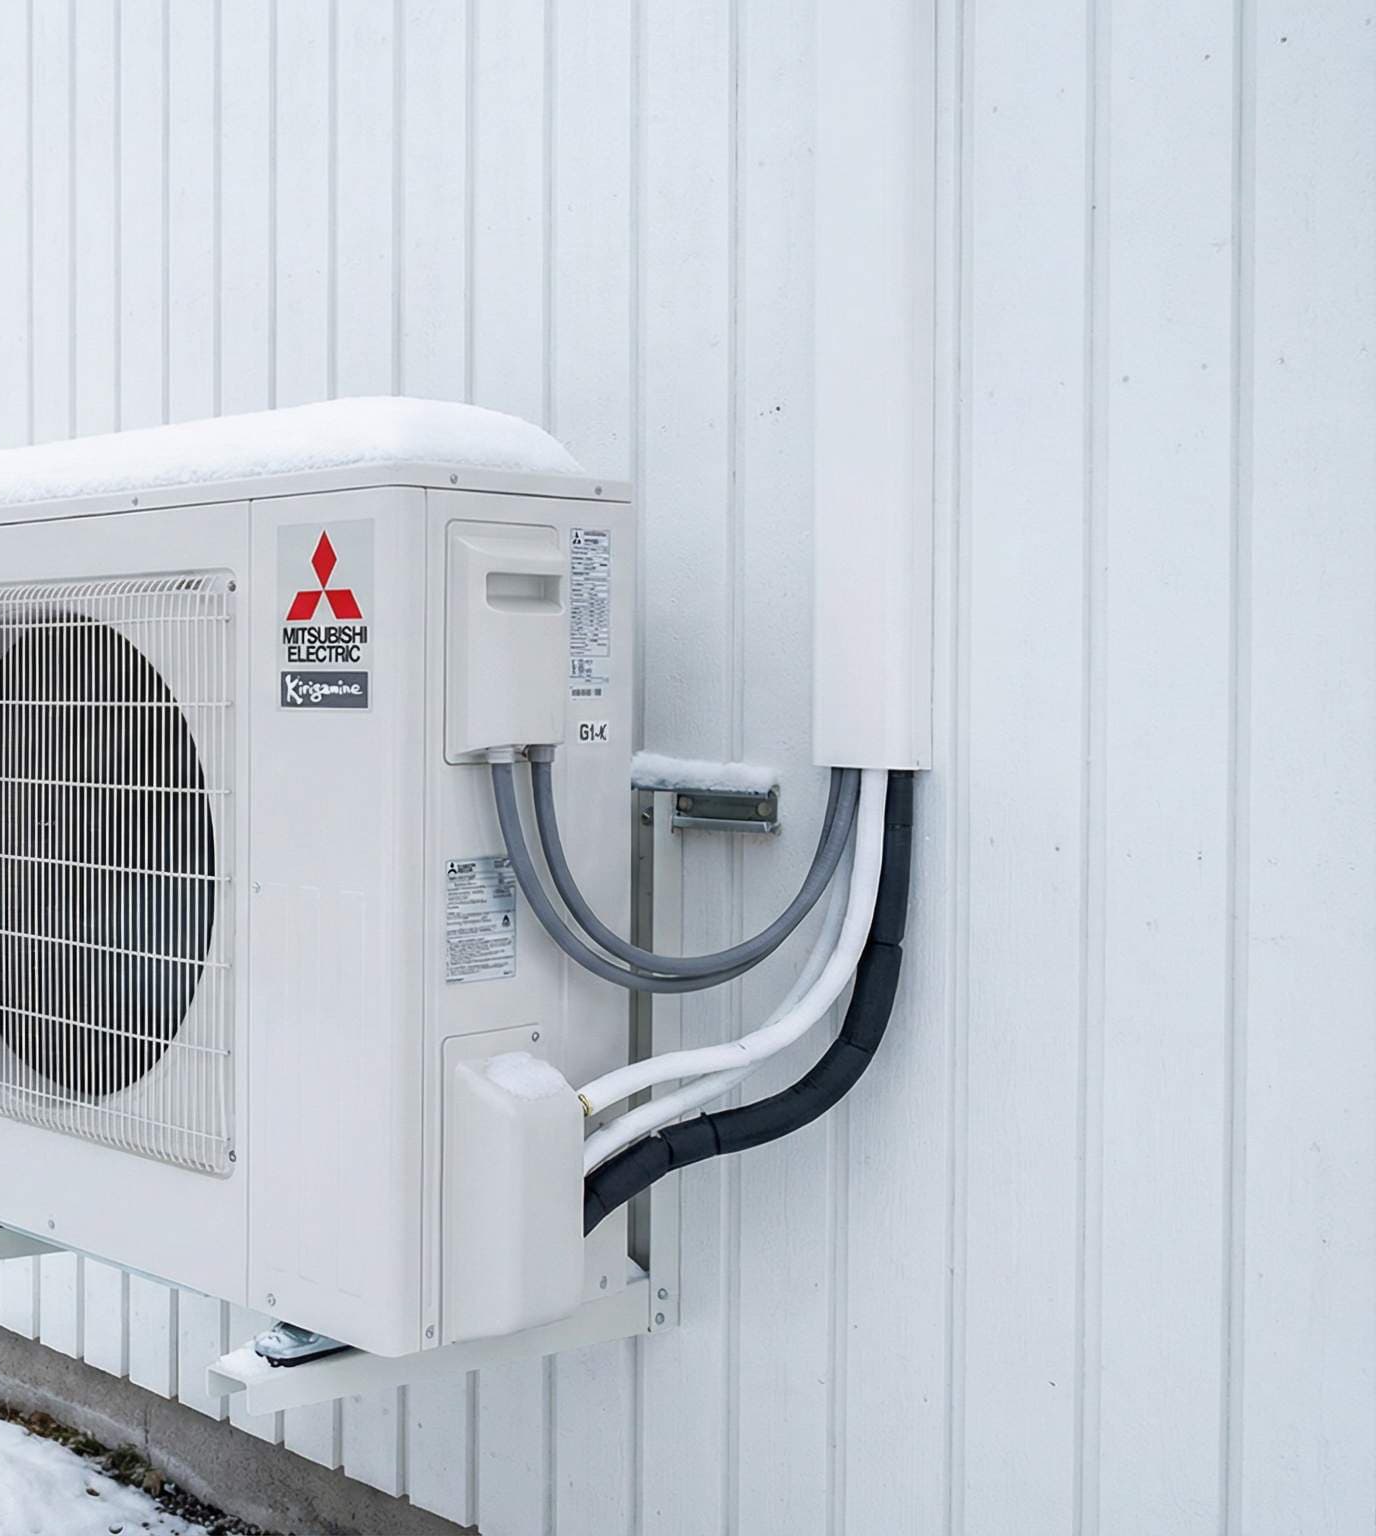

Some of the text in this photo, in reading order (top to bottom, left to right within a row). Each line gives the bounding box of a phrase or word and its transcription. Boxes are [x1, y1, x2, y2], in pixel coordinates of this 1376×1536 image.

[283, 626, 367, 644] MITSUBISHI
[288, 645, 360, 662] ELECTRIC
[285, 674, 363, 704] Kirigamine
